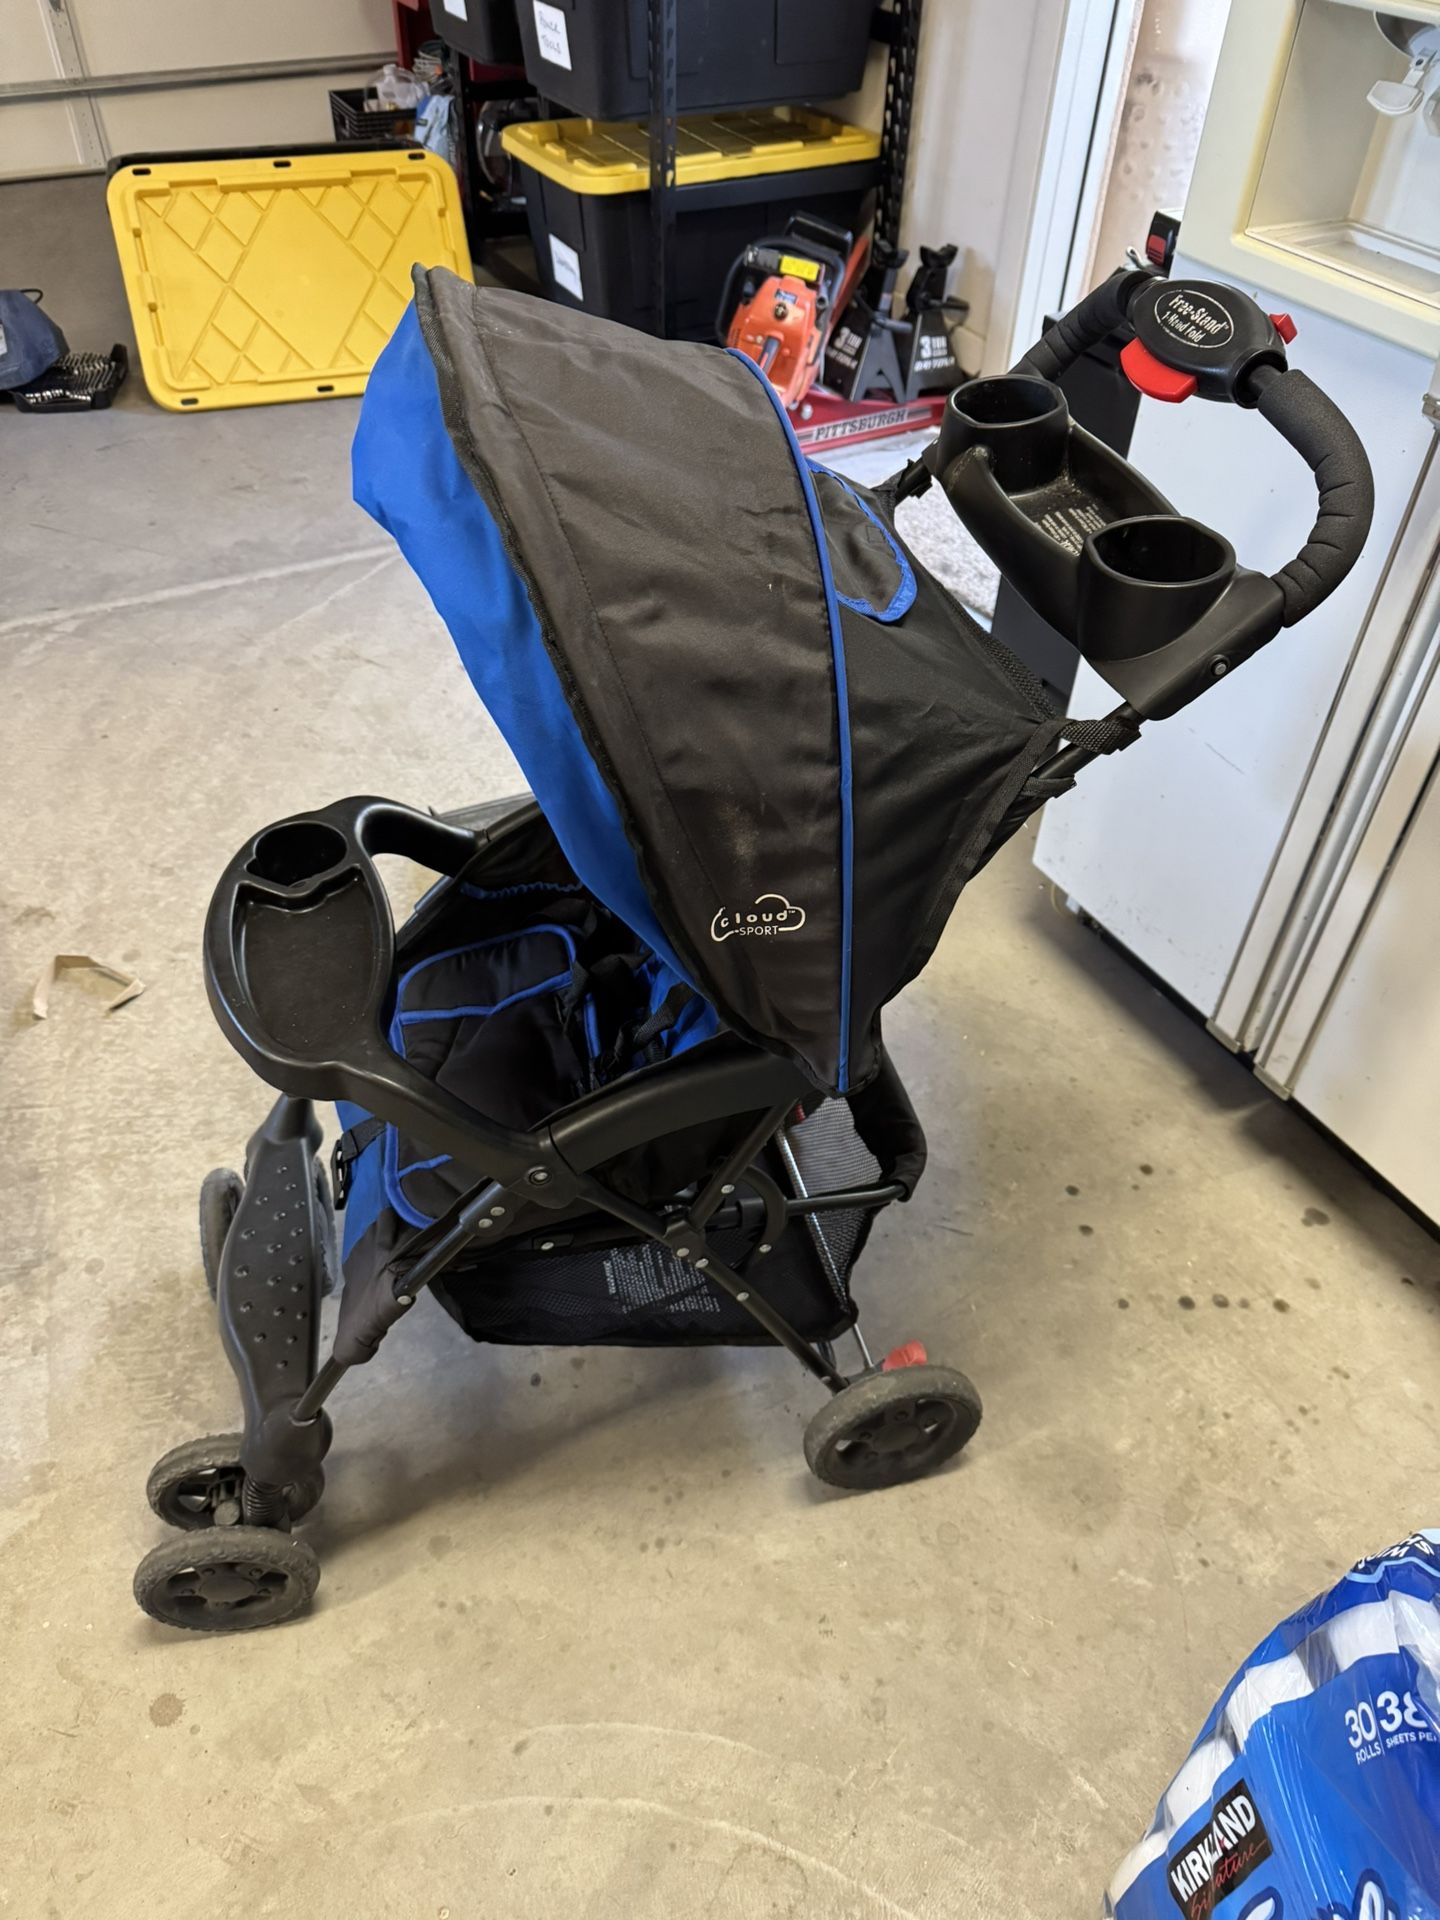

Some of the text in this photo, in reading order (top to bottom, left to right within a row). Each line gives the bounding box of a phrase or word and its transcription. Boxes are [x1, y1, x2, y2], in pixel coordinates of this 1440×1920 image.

[1161, 311, 1207, 343] 1-Hand Fold
[920, 335, 931, 359] 3
[815, 408, 906, 440] PITTSBURGH
[721, 910, 788, 928] cloud
[739, 925, 779, 936] SPORT
[1345, 1701, 1377, 1749] 30
[1385, 1731, 1437, 1749] SHEETS PE
[1171, 1795, 1255, 1902] KIRKLAND
